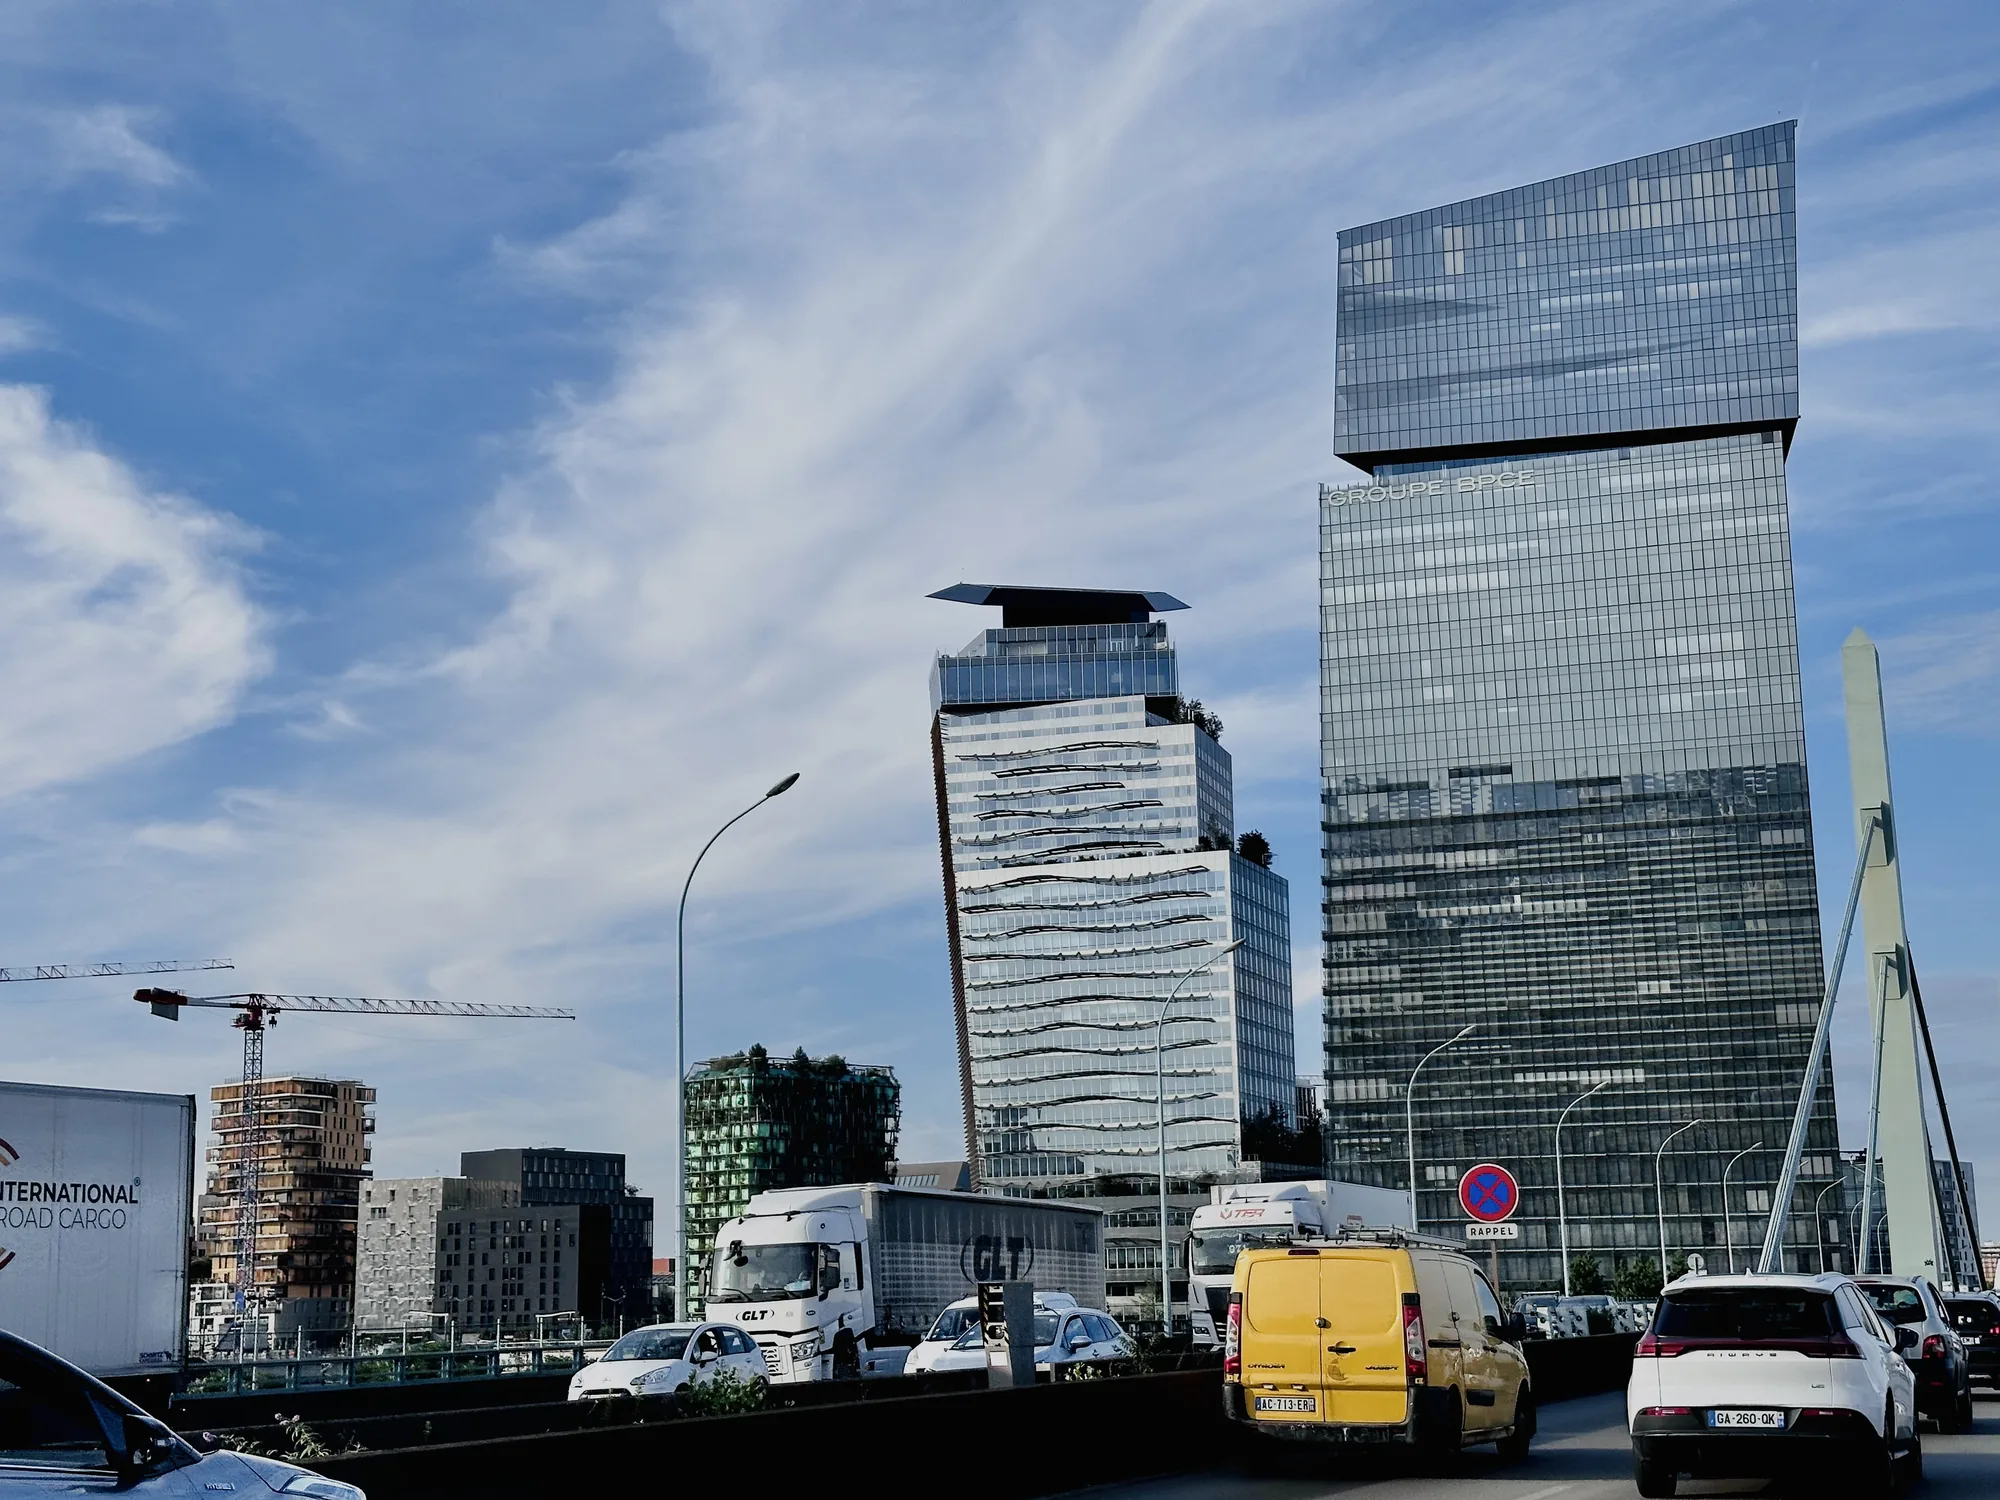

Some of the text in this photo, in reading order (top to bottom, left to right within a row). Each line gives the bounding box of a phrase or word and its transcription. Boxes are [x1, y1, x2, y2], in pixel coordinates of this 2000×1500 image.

[1328, 469, 1535, 507] GROUPE BPCE
[0, 1181, 138, 1204] TERNATIONAL
[59, 1208, 126, 1230] CARGO
[1470, 1227, 1514, 1236] RAPPEL
[973, 1234, 1025, 1281] GLT
[742, 1310, 768, 1321] GLT
[1262, 1399, 1309, 1410] AC-713-ER
[1716, 1413, 1775, 1425] GA-260-QK
